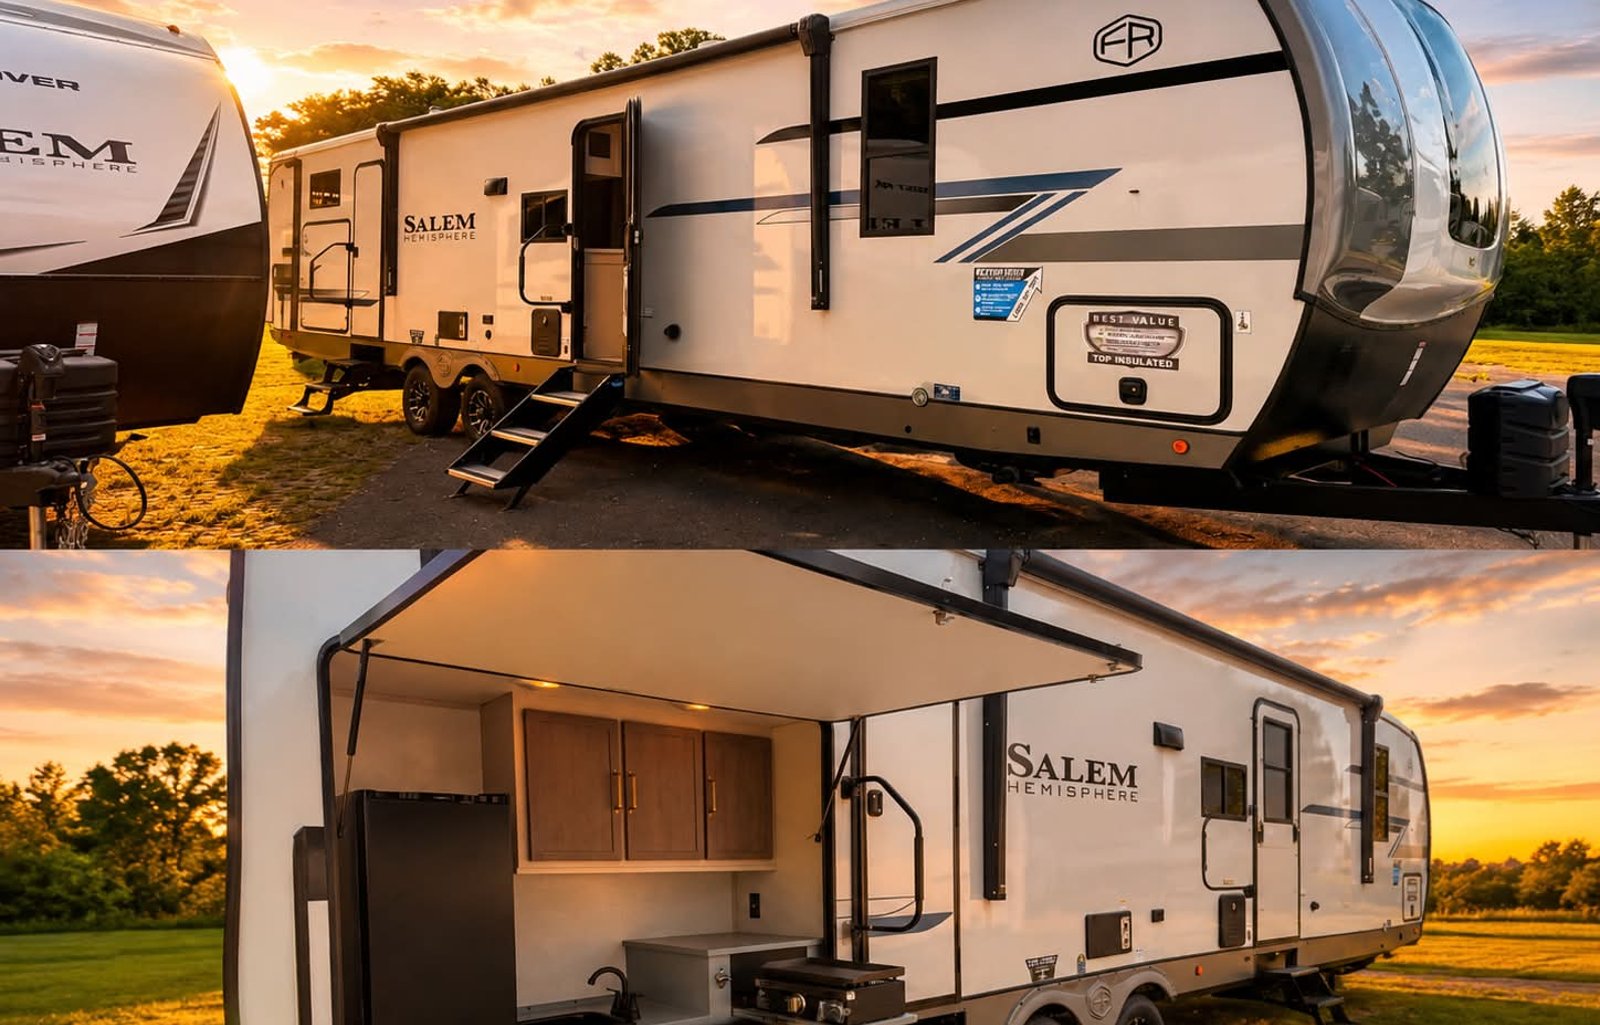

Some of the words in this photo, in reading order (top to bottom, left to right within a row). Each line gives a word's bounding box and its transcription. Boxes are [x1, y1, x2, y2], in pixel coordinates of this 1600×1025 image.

[404, 212, 476, 234] SALEM
[403, 231, 476, 243] HEMISPHERE
[1093, 314, 1123, 324] BEST
[1132, 315, 1175, 326] VALUE
[1092, 354, 1112, 363] TOP
[1114, 356, 1173, 368] INSULATED
[1007, 742, 1138, 788] SALEM
[1007, 780, 1139, 803] HEMISPHERE
